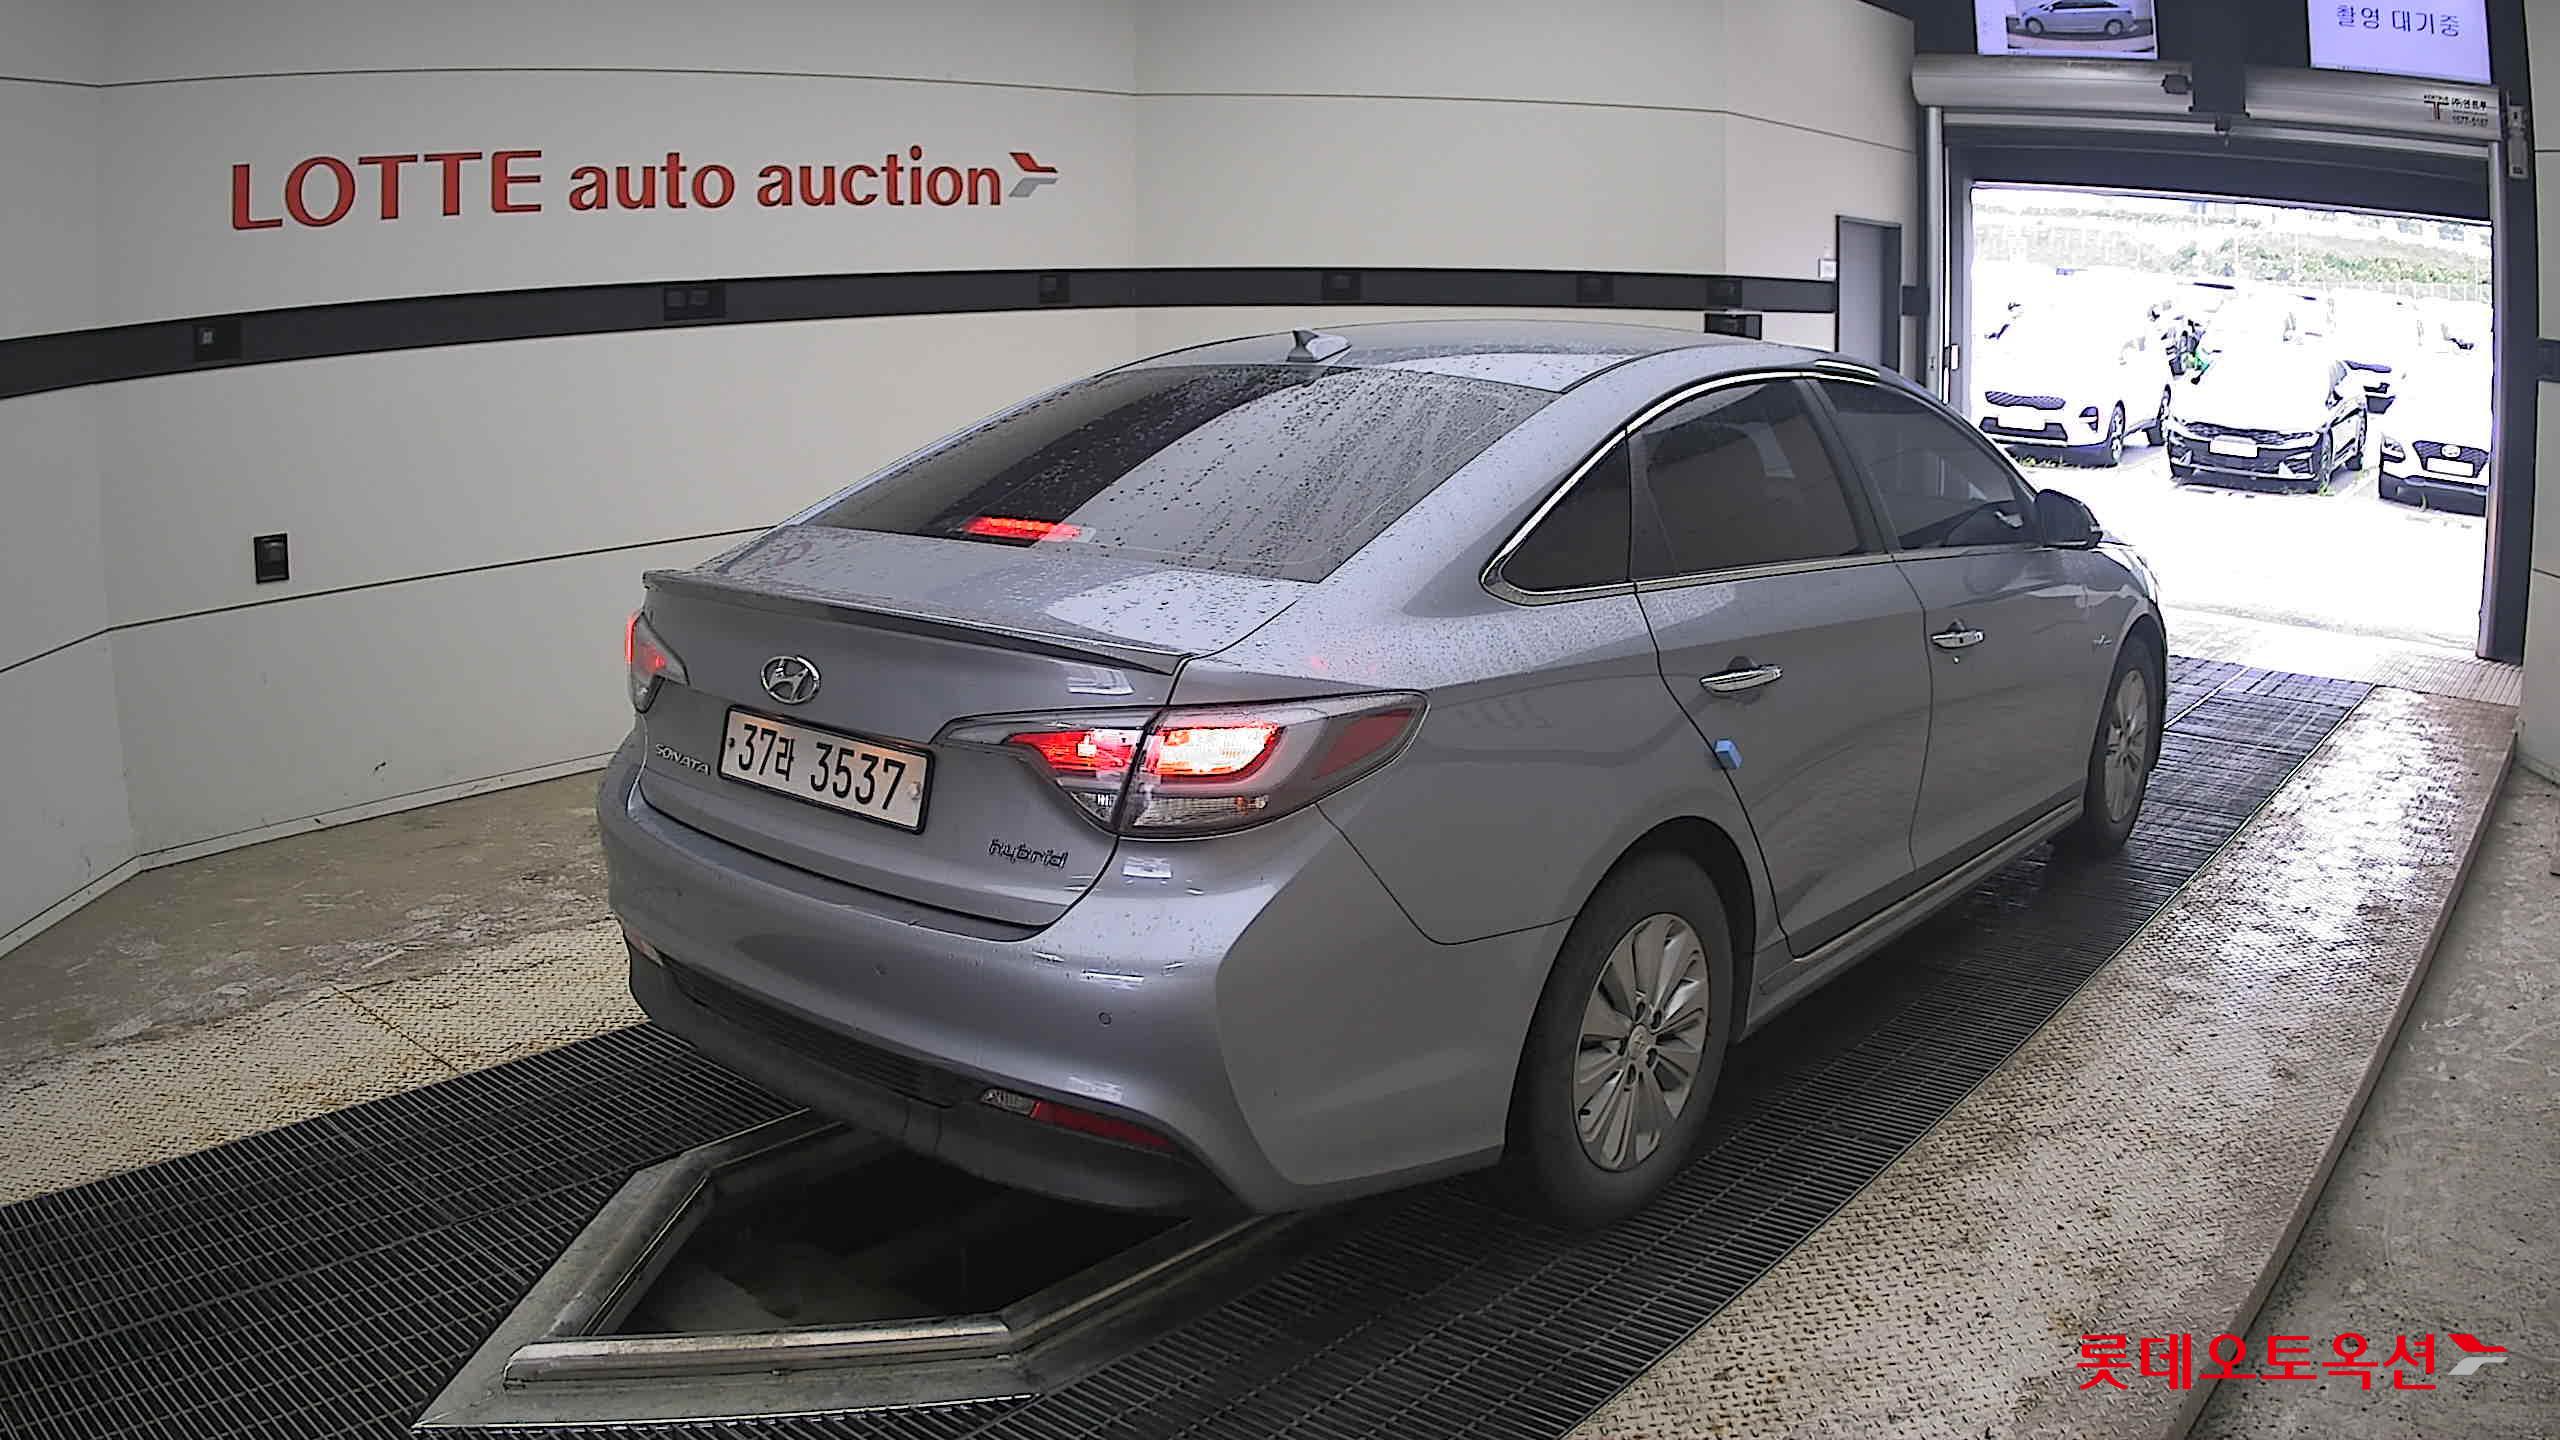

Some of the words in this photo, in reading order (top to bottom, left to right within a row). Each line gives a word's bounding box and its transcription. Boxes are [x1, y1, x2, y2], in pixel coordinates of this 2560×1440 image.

[2337, 5, 2380, 30] 촬영
[2392, 10, 2460, 37] 대기중
[232, 150, 542, 230] LOTTE
[570, 151, 736, 209] auto
[757, 146, 1004, 207] auction
[655, 743, 711, 777] SONATA
[738, 724, 797, 782] 37라
[810, 742, 907, 810] 3537
[988, 839, 1068, 869] hybrid
